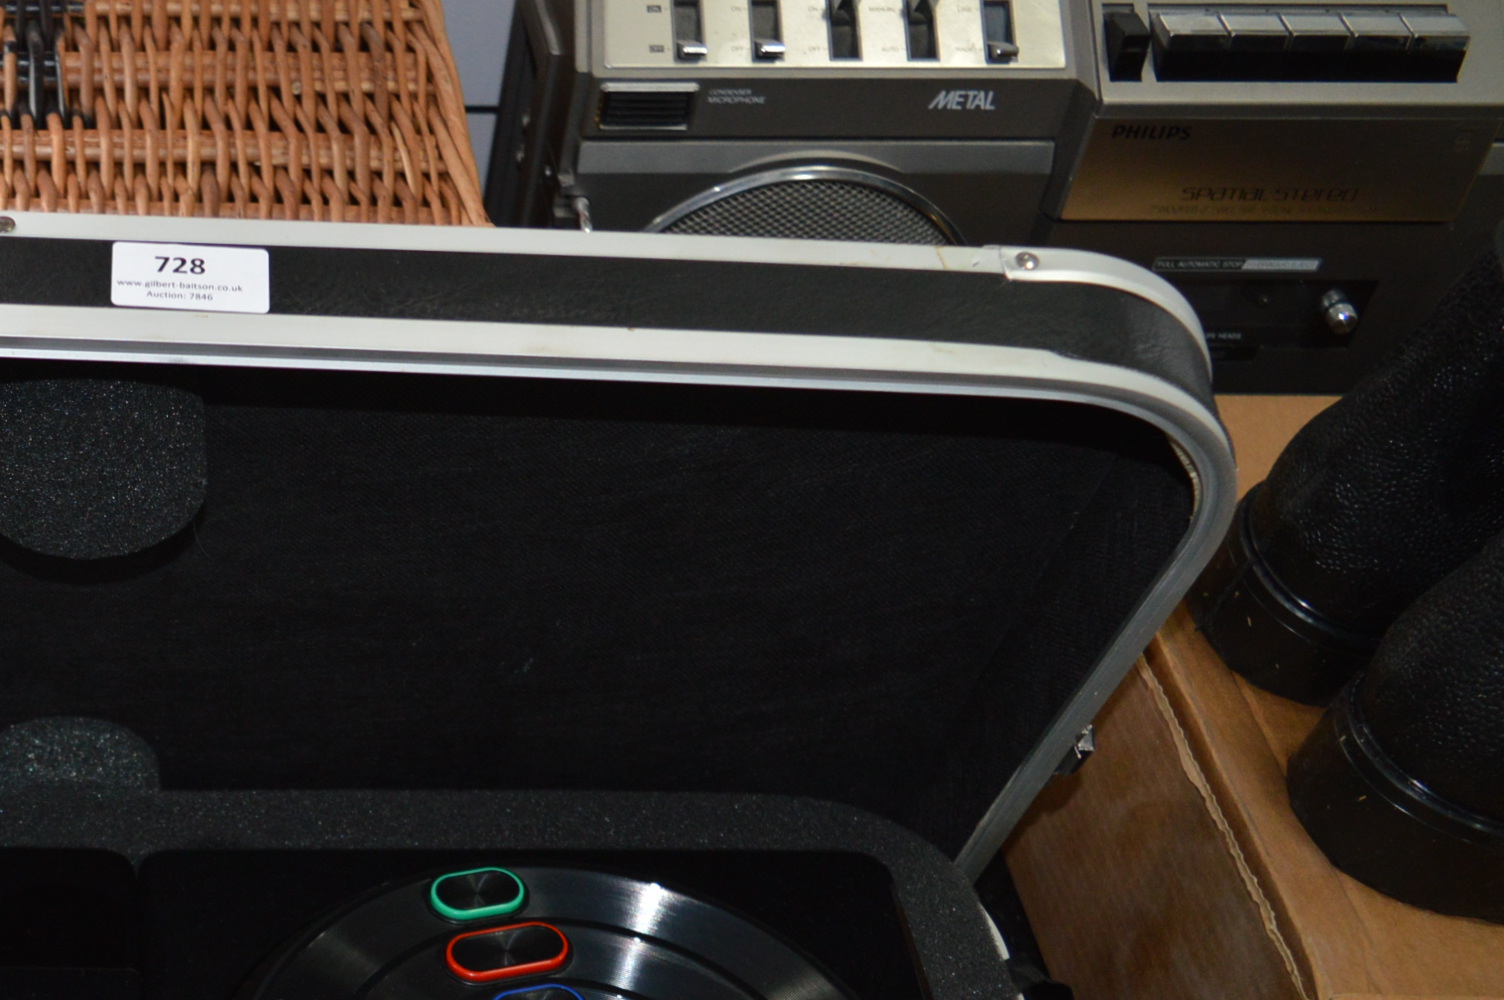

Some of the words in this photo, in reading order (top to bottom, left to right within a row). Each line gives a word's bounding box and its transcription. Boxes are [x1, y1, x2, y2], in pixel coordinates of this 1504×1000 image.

[928, 90, 996, 110] METAL
[1111, 125, 1192, 141] PHILIPS
[154, 256, 206, 275] 728
[116, 279, 243, 293] www.gilbert-baitson.co.uk
[146, 291, 187, 300] Auction:
